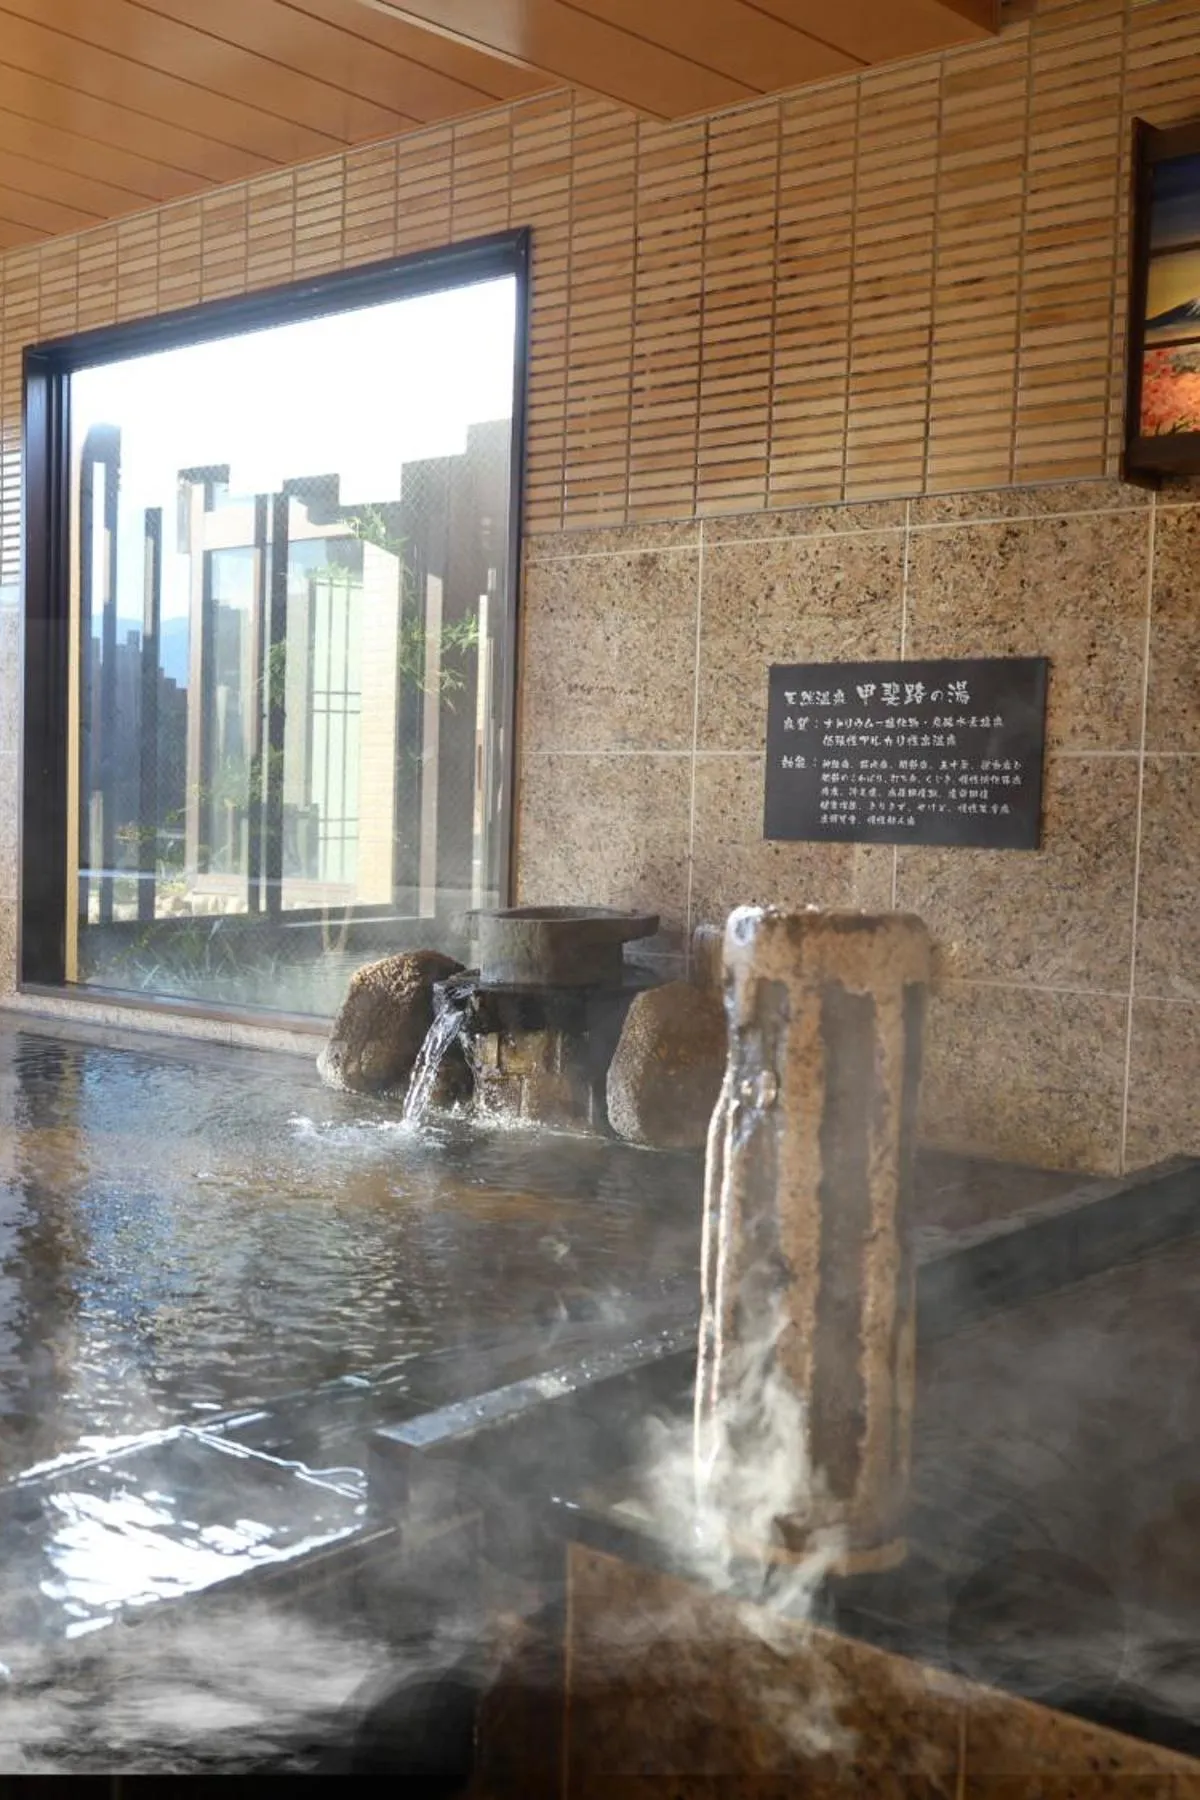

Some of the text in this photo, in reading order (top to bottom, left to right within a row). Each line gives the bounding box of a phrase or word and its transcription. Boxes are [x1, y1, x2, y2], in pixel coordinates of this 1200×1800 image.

[856, 680, 971, 706] 甲斐路の湯
